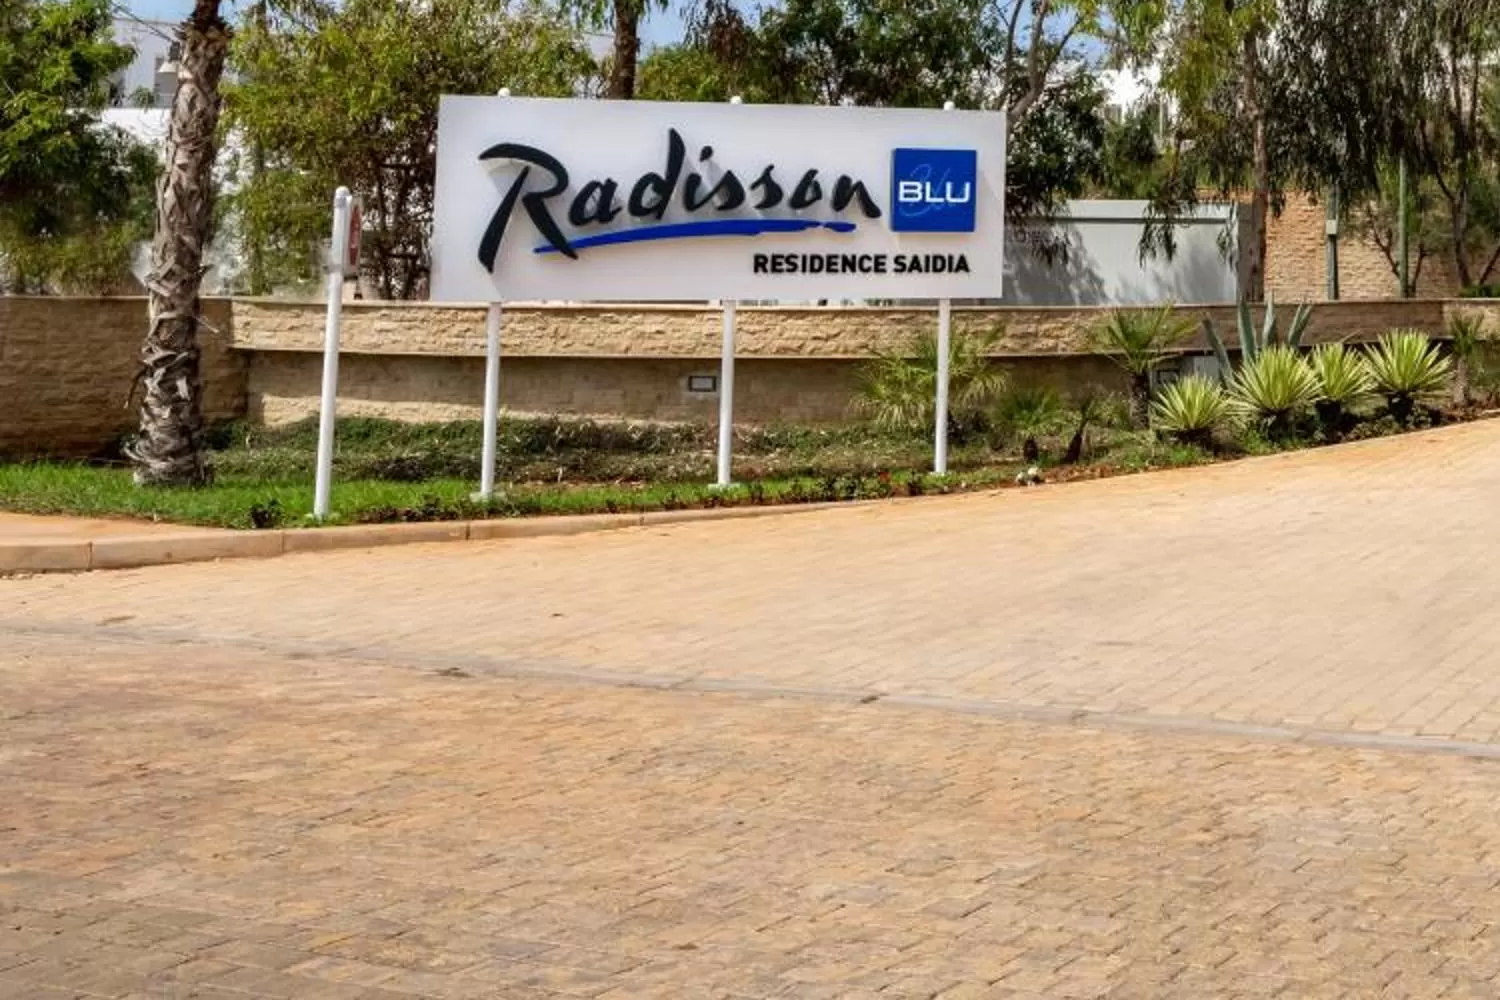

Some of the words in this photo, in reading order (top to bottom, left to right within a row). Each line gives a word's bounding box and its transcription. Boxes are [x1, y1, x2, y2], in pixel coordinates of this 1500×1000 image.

[478, 127, 882, 273] Radisson
[899, 180, 970, 203] BLU
[753, 253, 887, 273] RESIDENCE
[893, 253, 970, 273] SAIDIA
